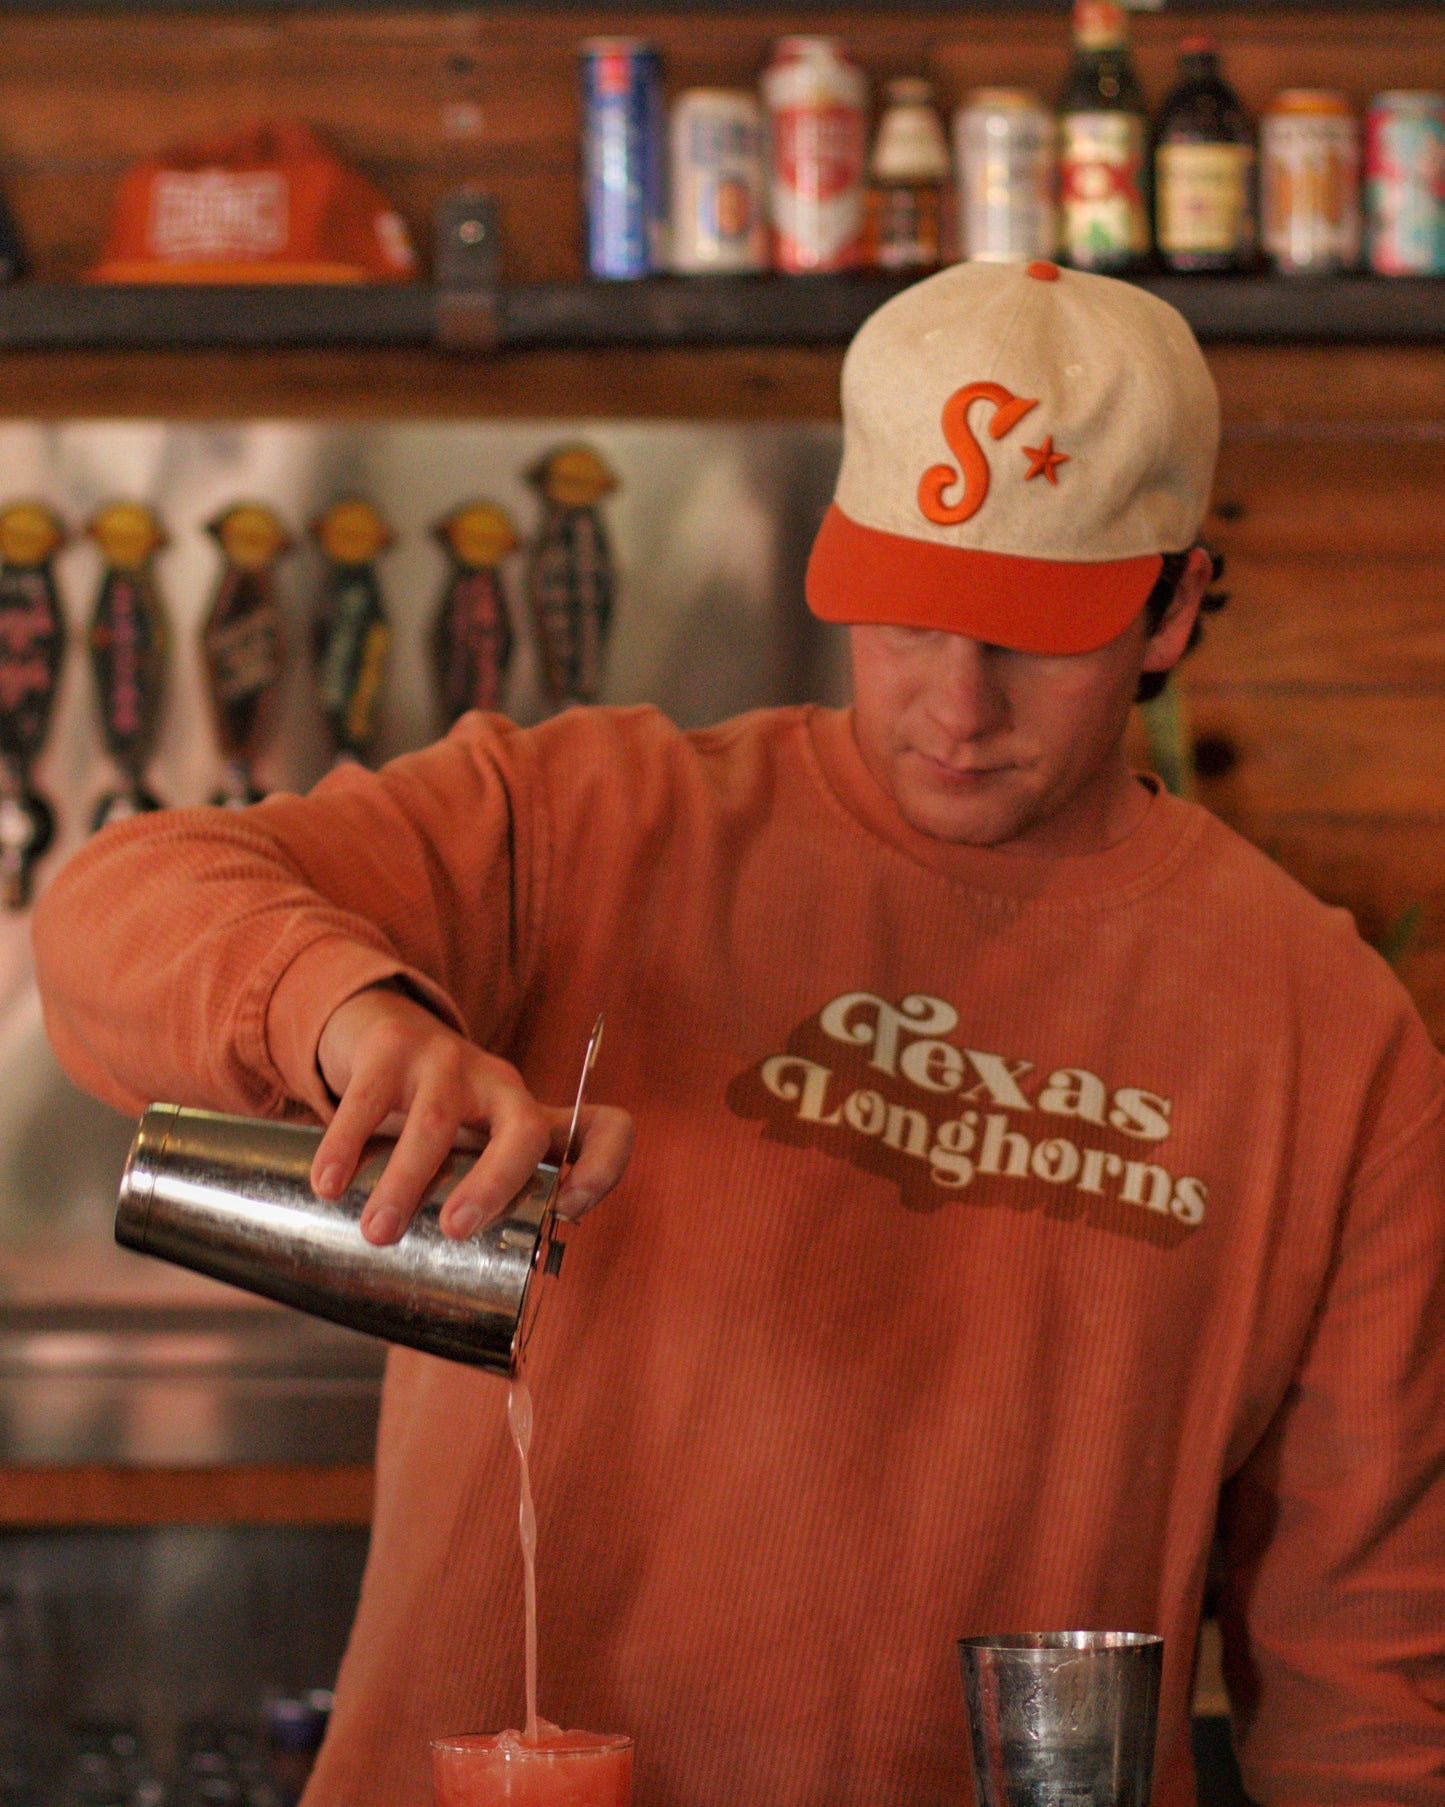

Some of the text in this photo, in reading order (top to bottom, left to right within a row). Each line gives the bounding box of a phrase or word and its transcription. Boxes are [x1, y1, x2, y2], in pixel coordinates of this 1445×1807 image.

[917, 381, 1039, 526] S
[761, 1055, 1208, 1225] Longhorns
[820, 992, 1172, 1141] Texas
